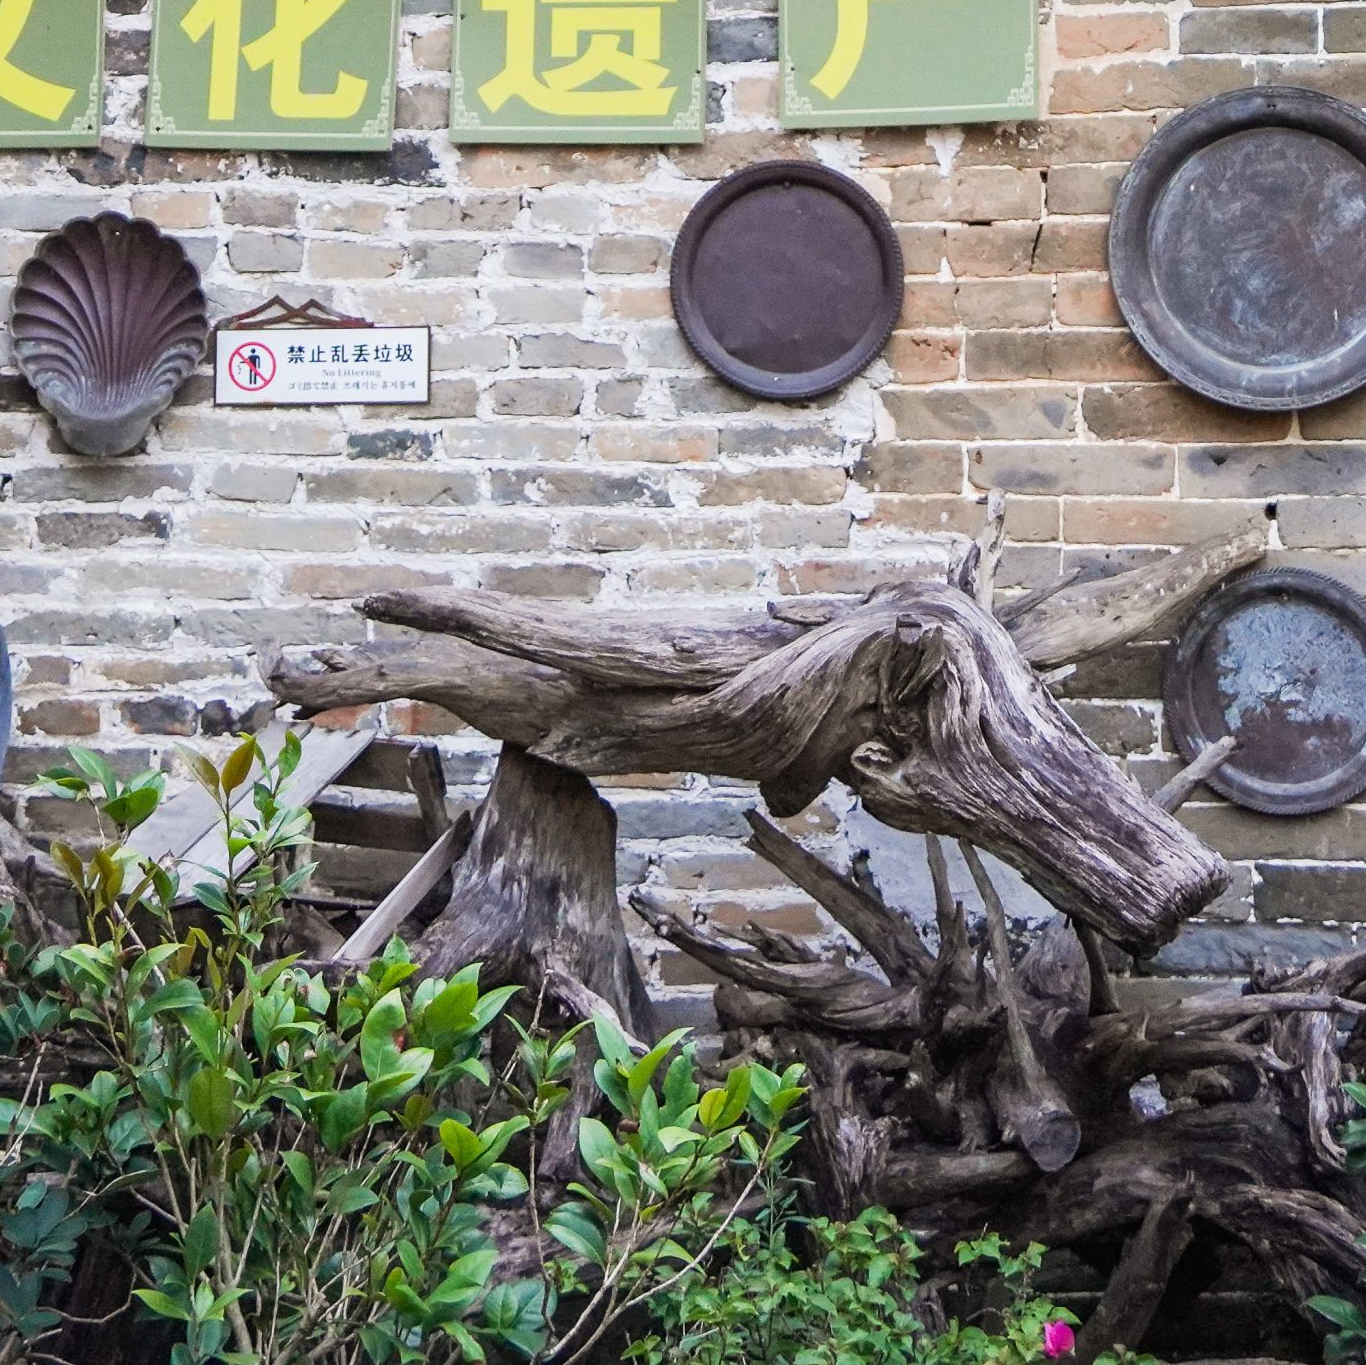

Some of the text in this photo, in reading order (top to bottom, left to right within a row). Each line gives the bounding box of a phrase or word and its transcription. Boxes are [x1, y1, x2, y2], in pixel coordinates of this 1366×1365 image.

[287, 344, 414, 364] 禁止乱丢垃圾
[322, 368, 382, 379] No Littering
